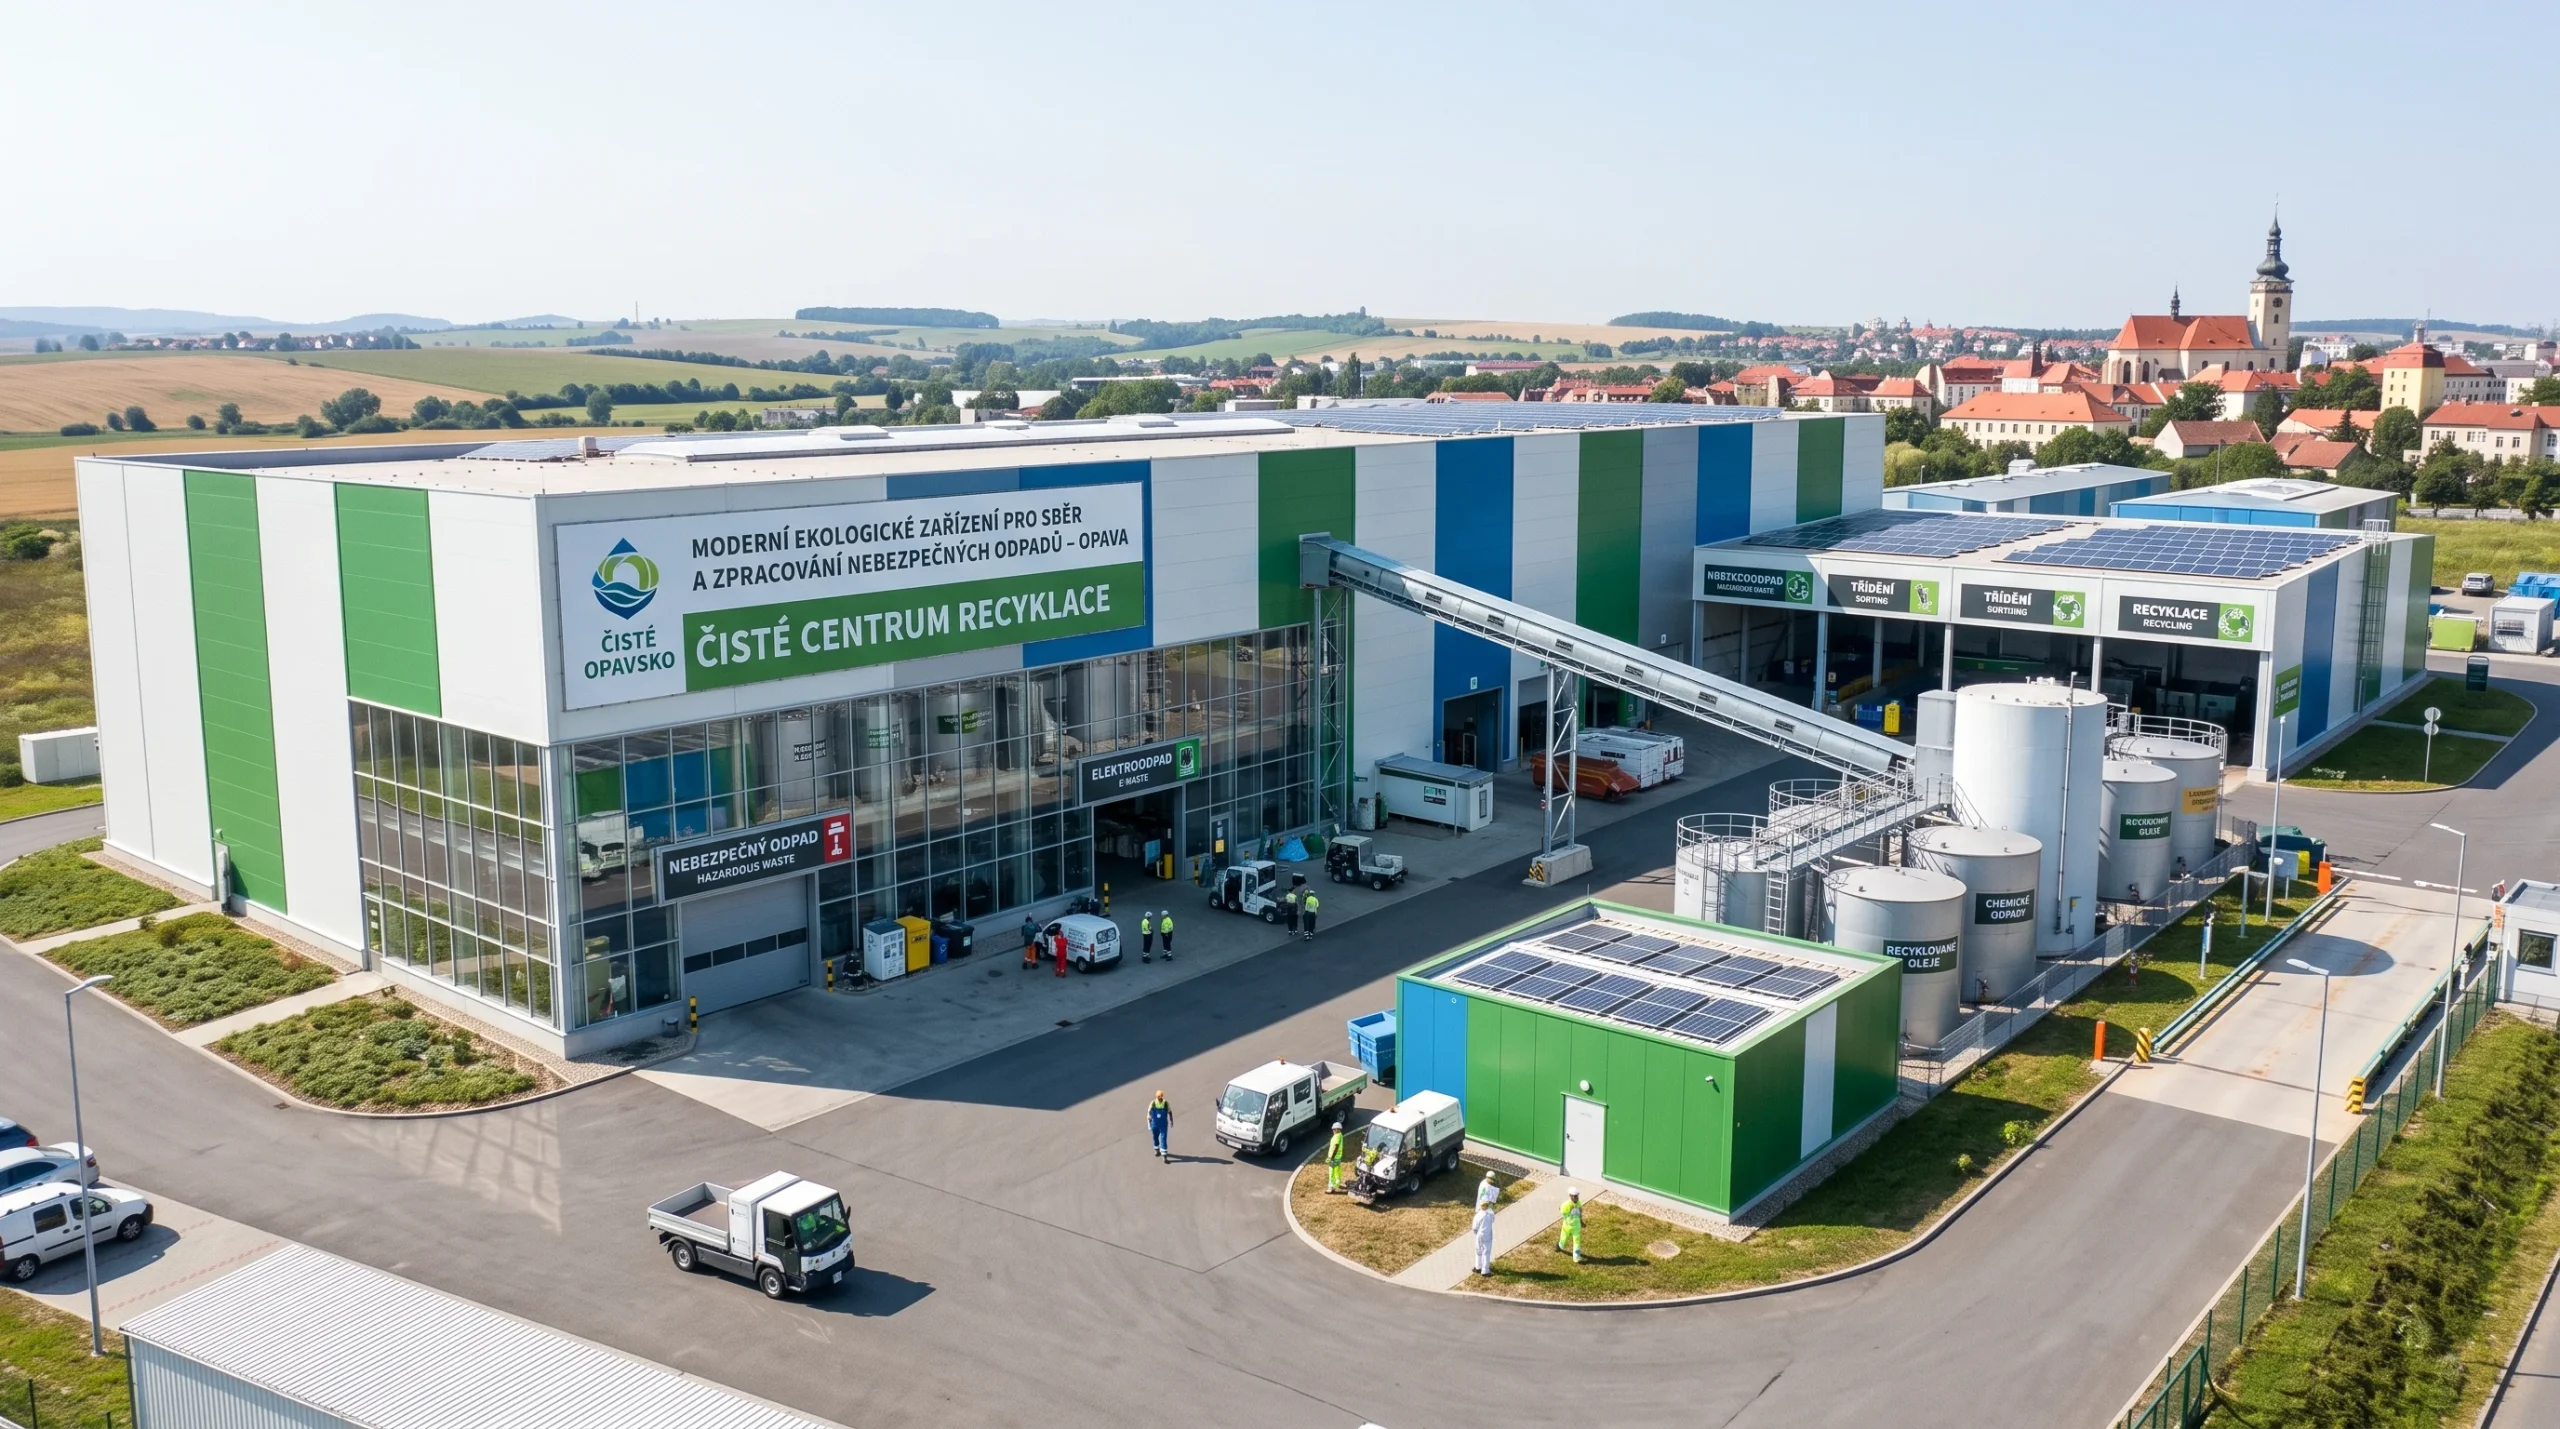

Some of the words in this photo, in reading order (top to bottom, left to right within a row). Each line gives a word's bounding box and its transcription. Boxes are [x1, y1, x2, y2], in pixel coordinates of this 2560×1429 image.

[692, 525, 790, 558] MODERNÍ
[795, 515, 915, 549] EKOLOGICKÉ
[919, 508, 1000, 538] ZAŘÍZENÍ
[1004, 510, 1037, 530] PRO
[1041, 502, 1082, 526] SBĚR
[692, 571, 708, 591] A
[713, 551, 843, 589] ZPRACOVÁNÍ
[848, 539, 990, 574] NEBEZPEČNÝCH
[994, 530, 1062, 559] ODPADŮ
[1079, 528, 1129, 550] OPAVA
[2132, 603, 2208, 620] RECYKLACE
[2143, 618, 2193, 631] RECYCLING
[601, 625, 657, 653] ČISTÉ
[696, 614, 791, 668] ČISTÉ
[801, 605, 949, 653] CENTRUM
[959, 584, 1111, 632] RECYKLACE
[584, 651, 675, 679] OPAVSKO
[1092, 753, 1173, 781] ELEKTROODPAD
[669, 837, 767, 874] NEBEZPEČNÝ
[770, 830, 819, 852] ODPAD
[697, 861, 760, 884] HAZARDOUS
[762, 854, 795, 870] WASTE
[1985, 894, 2030, 908] CHEMICKÉ
[1990, 908, 2026, 920] ODPADY
[1886, 941, 1957, 956] RECYKLOVANÉ
[1908, 957, 1941, 968] OLEJE
